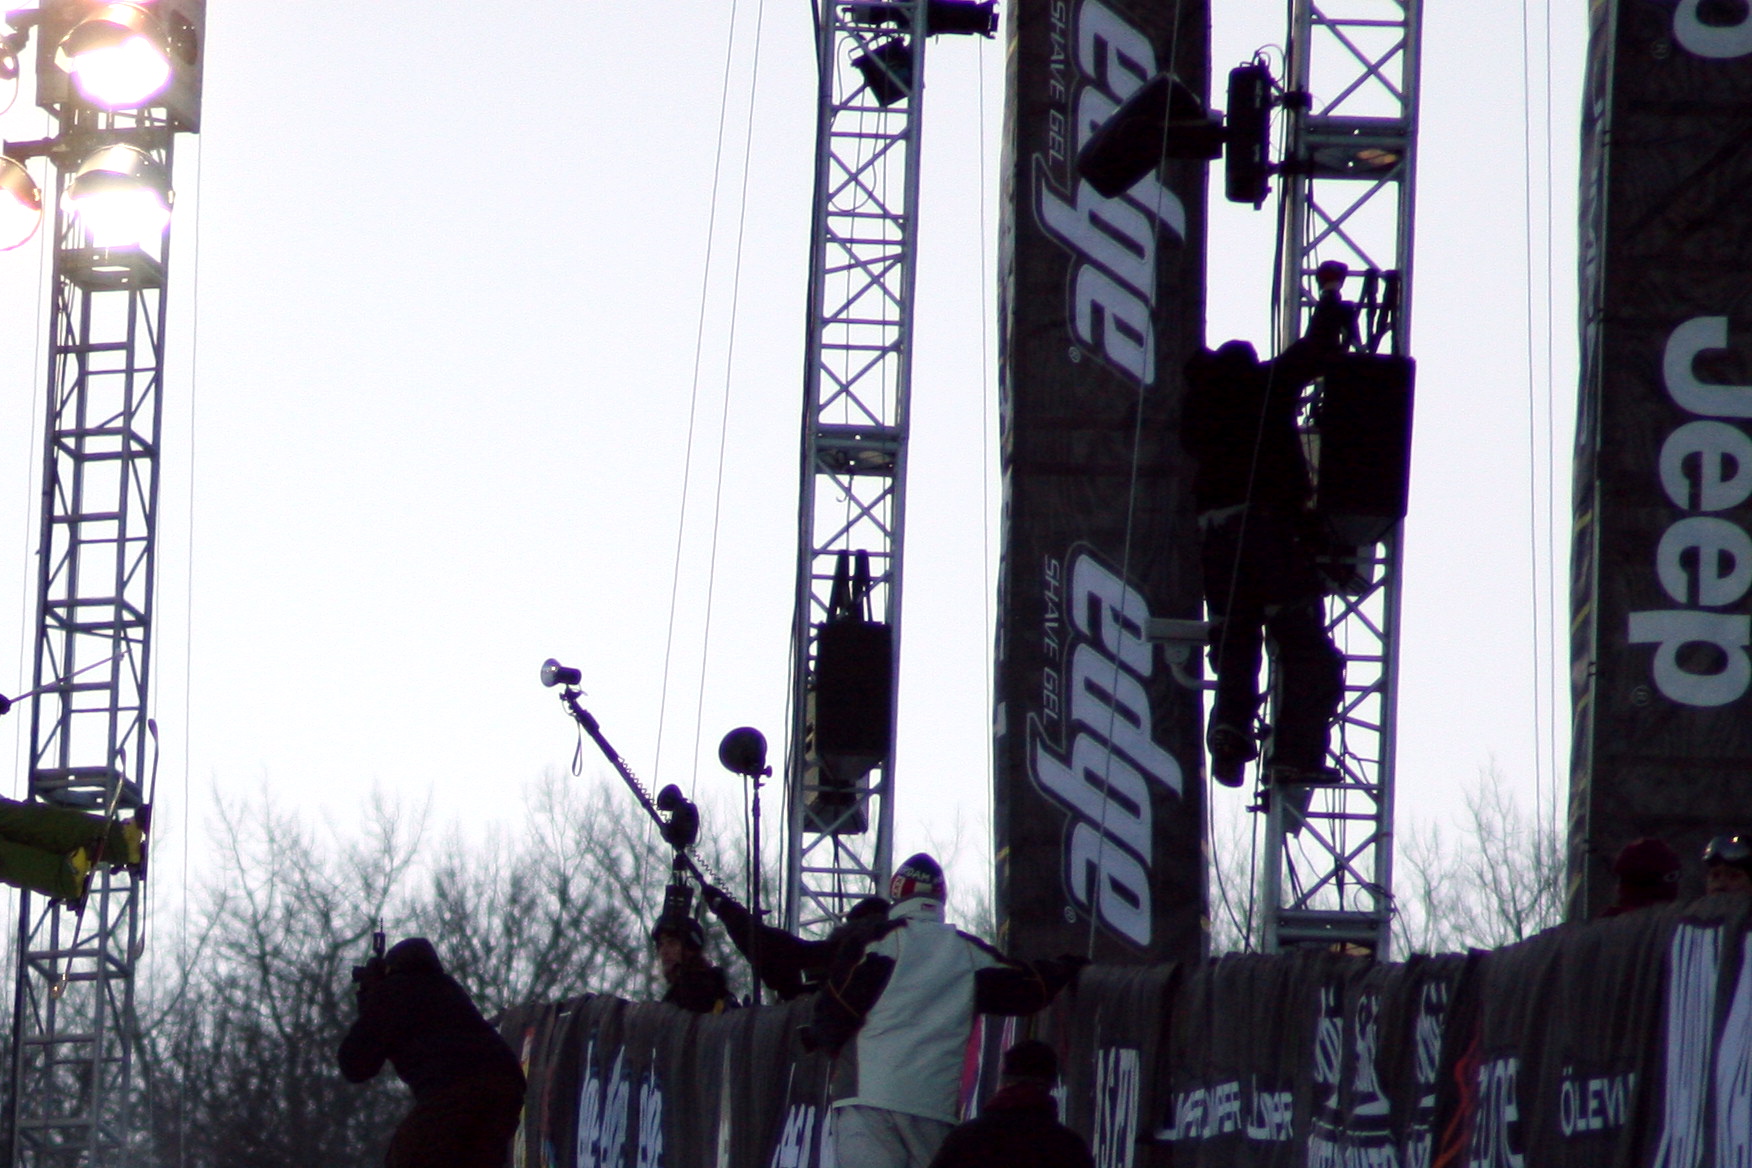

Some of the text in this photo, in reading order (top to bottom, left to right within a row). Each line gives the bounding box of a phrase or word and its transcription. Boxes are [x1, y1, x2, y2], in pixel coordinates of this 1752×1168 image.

[1048, 0, 1066, 167] SHAVE GEL
[1043, 555, 1060, 726] SHAVE GEL
[1628, 316, 1752, 708] Jeep
[1037, 553, 1183, 947] edge
